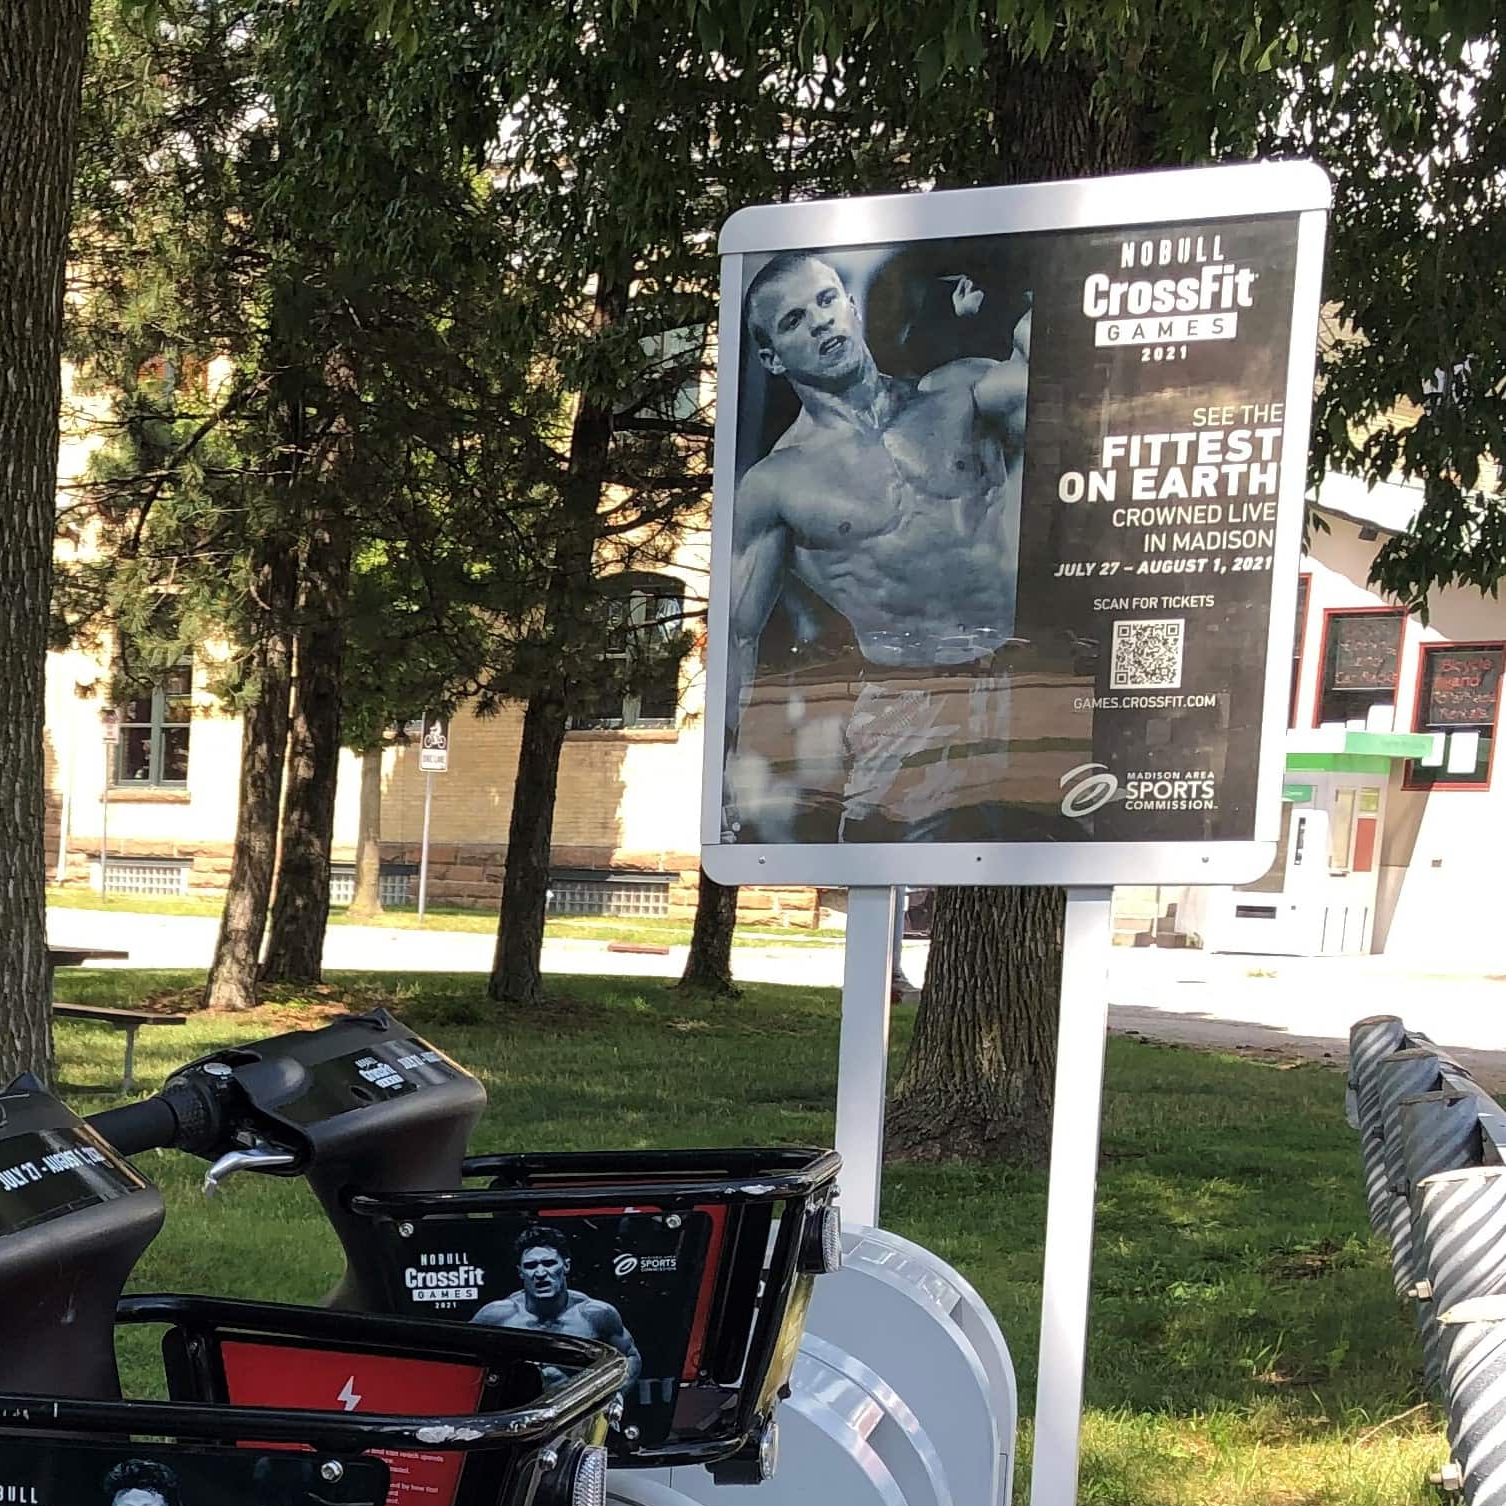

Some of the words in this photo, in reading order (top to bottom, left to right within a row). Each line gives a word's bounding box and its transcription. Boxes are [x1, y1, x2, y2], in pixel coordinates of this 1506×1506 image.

[1121, 235, 1224, 268] NOBULL
[1083, 264, 1256, 318] CrossFit
[1107, 318, 1224, 341] GAMES
[1141, 344, 1188, 362] 2021
[1193, 407, 1234, 427] SEE
[1241, 403, 1283, 424] THE
[1102, 427, 1282, 469] FITTEST
[1058, 469, 1117, 503] ON
[1131, 462, 1278, 500] EARTH
[1112, 504, 1222, 528] CROWNED
[1227, 502, 1276, 524] LIVE
[1144, 532, 1166, 553] IN
[1172, 529, 1274, 551] MADISON
[1053, 562, 1098, 577] JULY
[1099, 562, 1120, 576] 27
[1136, 558, 1208, 575] AUGUST
[1212, 558, 1226, 575] 1,
[1231, 556, 1273, 572] 2021
[1093, 598, 1129, 611] SCAN
[1132, 597, 1158, 609] FOR
[1161, 595, 1215, 609] TICKETS
[1073, 694, 1217, 710] GAMES.CROSSFIT.COM
[1126, 771, 1181, 780] MADISON
[1184, 771, 1215, 779] AREA
[1126, 780, 1215, 800] SPORTS
[1124, 800, 1215, 811] COMMISSION
[21, 1162, 43, 1181] 27
[640, 1259, 677, 1268] SPORTS
[405, 1266, 485, 1288] CrossFit
[417, 1289, 473, 1299] GAMES
